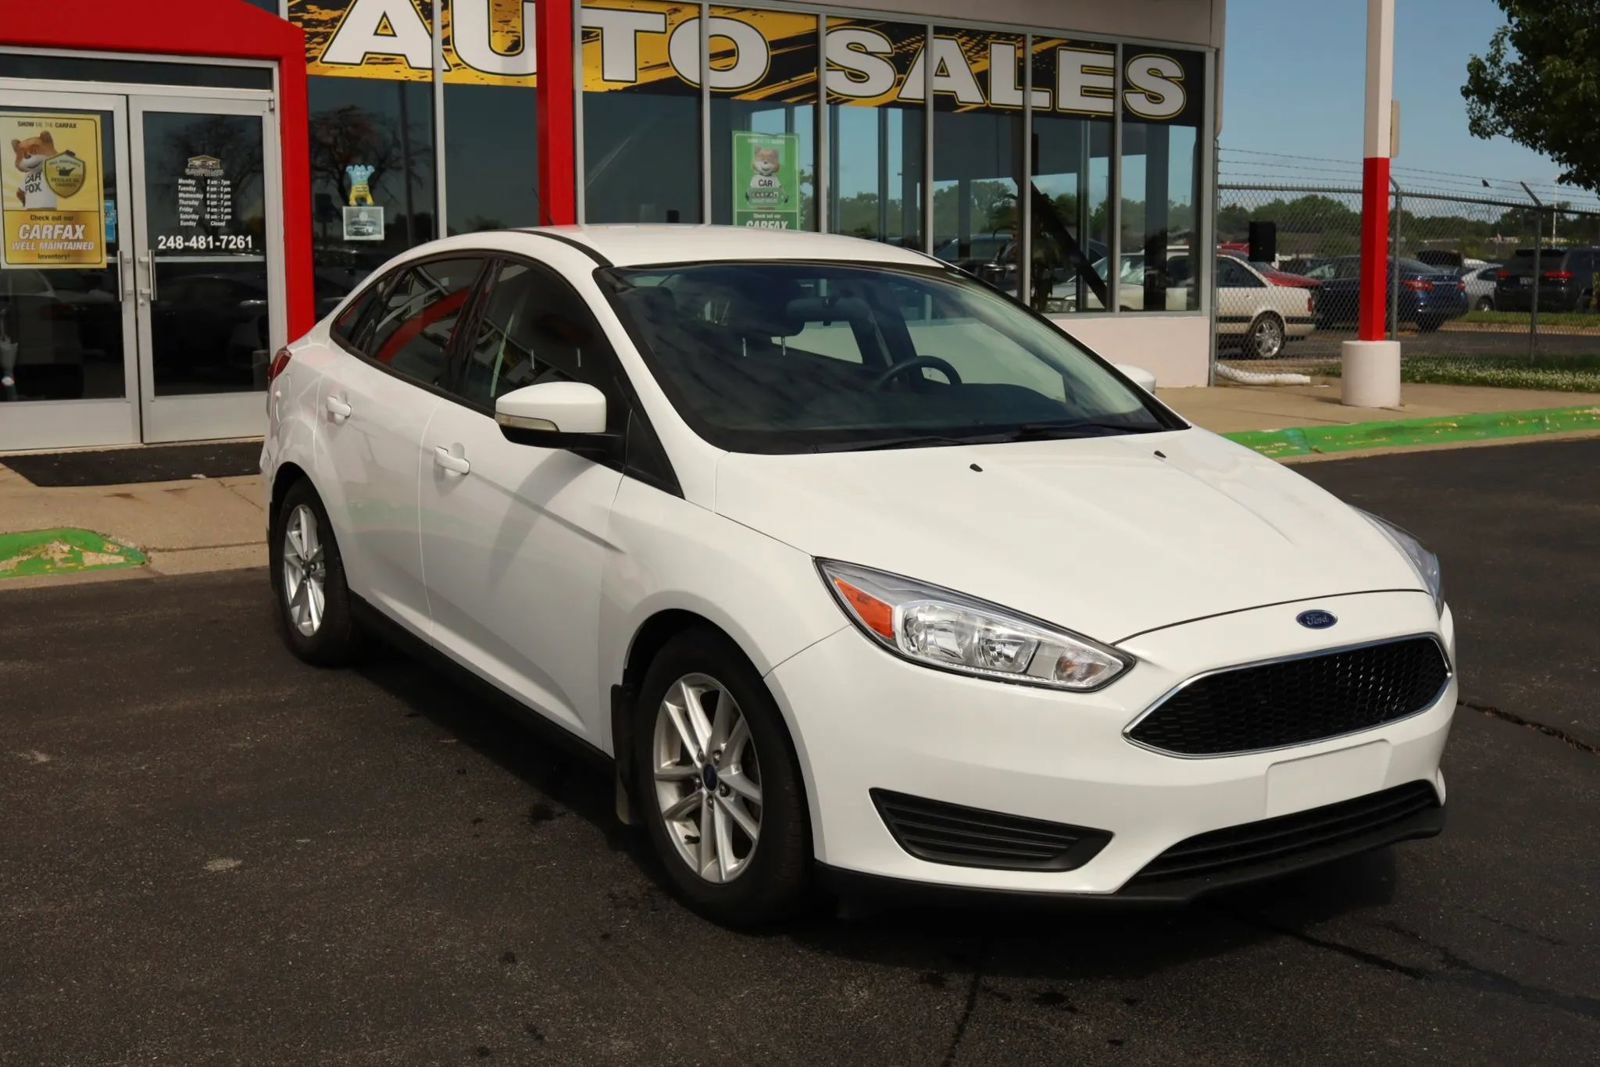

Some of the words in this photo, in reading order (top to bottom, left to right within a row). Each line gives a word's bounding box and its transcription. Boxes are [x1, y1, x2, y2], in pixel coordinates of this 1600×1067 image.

[320, 0, 772, 90] AUTO
[824, 26, 1187, 119] SALES
[25, 172, 42, 185] CAR
[25, 182, 42, 193] FOX
[178, 185, 196, 193] Tuesday
[758, 180, 773, 188] CAR
[178, 192, 204, 200] Wednesday
[180, 213, 200, 221] Saturday
[180, 220, 197, 228] Sunday
[745, 220, 789, 231] CARFAX
[19, 224, 86, 240] CARFAX
[13, 241, 36, 250] WELL
[40, 241, 94, 250] MAINTAINED
[158, 235, 252, 249] 248-481-7261
